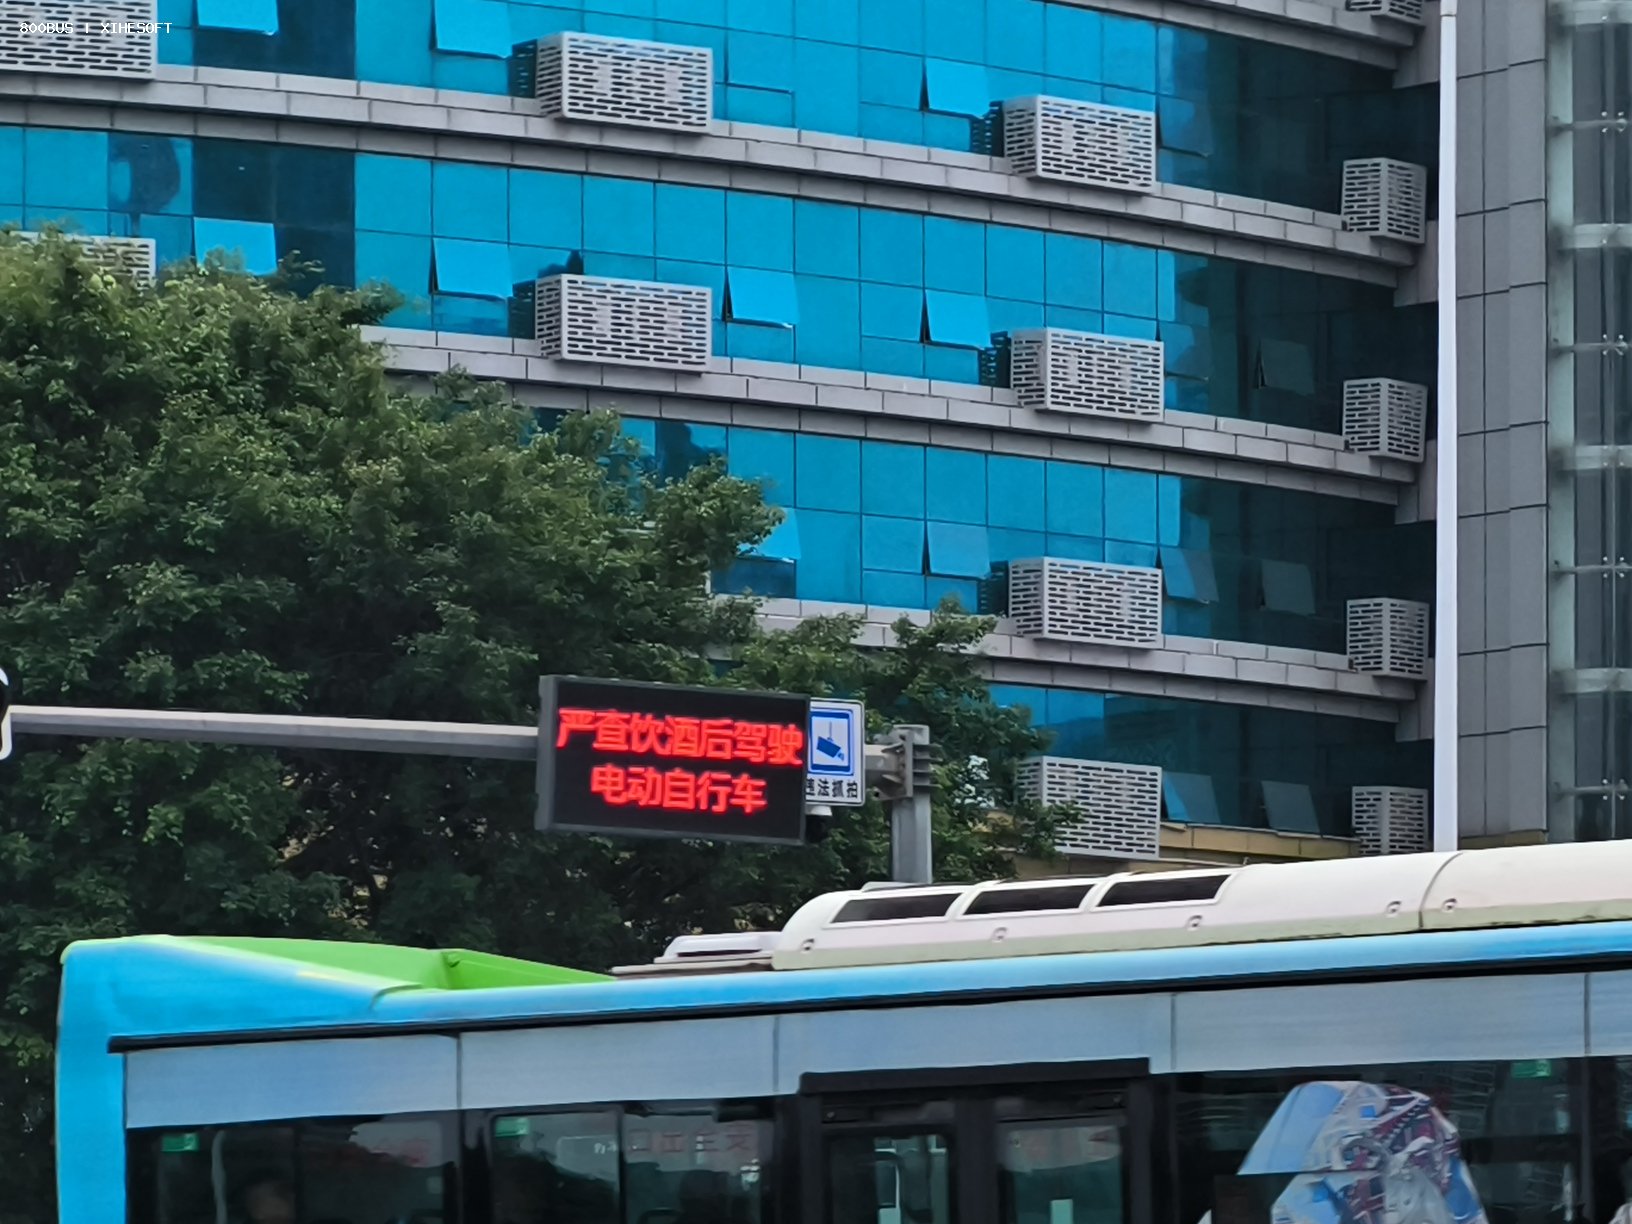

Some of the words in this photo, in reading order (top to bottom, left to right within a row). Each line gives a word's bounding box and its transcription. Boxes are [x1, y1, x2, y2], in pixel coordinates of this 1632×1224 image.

[555, 707, 805, 766] 严查饮酒后驾驶
[590, 763, 768, 815] 电动自行车
